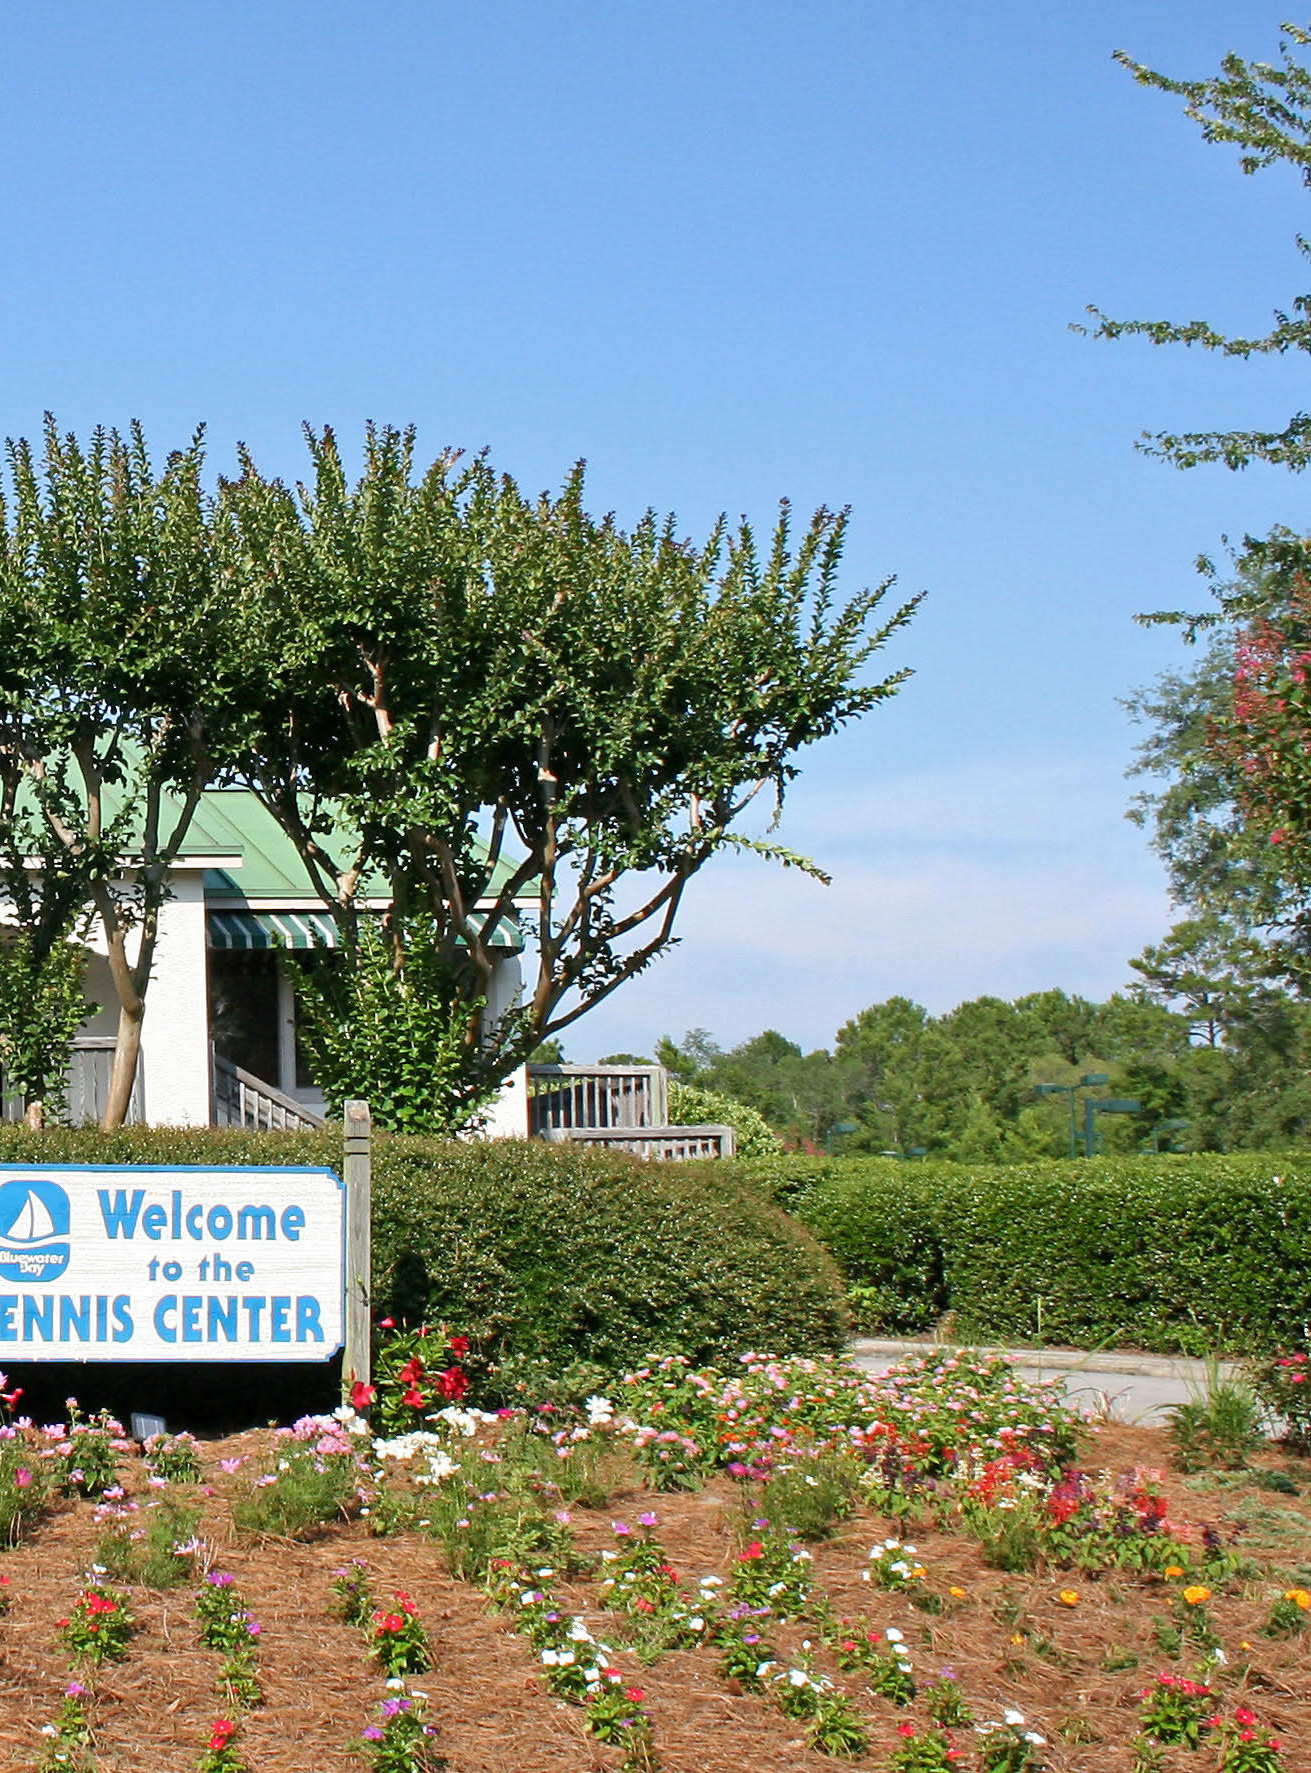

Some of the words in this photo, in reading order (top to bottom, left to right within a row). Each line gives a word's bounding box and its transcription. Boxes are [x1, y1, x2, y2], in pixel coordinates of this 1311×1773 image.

[97, 1189, 306, 1241] Welcome
[147, 1255, 183, 1281] to
[198, 1253, 255, 1282] the
[153, 1294, 325, 1343] CENTER
